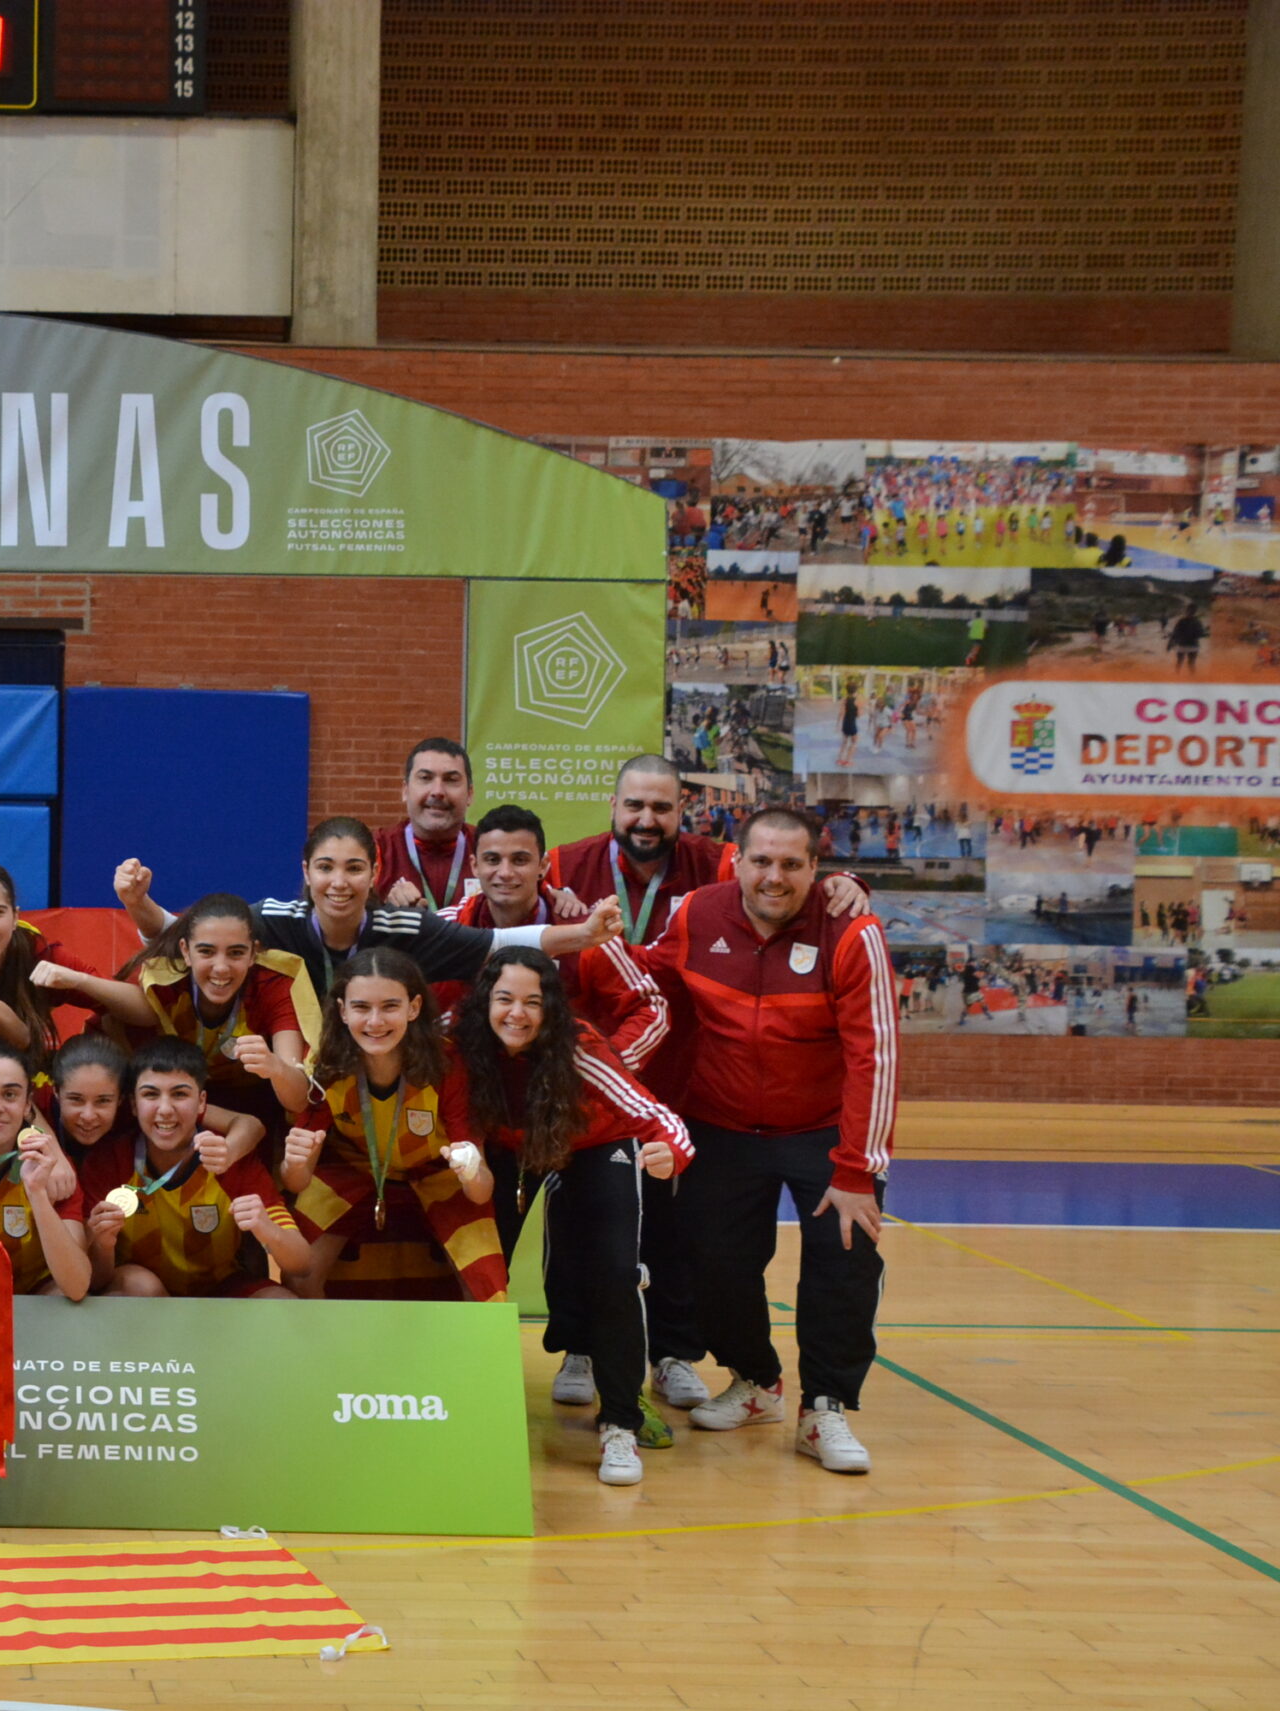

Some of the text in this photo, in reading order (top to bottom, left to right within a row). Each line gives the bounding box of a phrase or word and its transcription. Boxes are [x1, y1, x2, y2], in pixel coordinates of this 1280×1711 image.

[175, 11, 195, 30] 12
[175, 34, 194, 52] 13
[174, 57, 194, 75] 14
[174, 80, 194, 98] 15
[287, 518, 405, 529] SELECCIONES
[286, 528, 405, 540] AUTONÓMICAS
[287, 543, 405, 552] FUTSAL FEMENINO
[486, 742, 644, 753] CAMPEONATO DE ESPAÑA
[485, 757, 629, 770] SELECCIONE
[485, 770, 616, 785] AUTONÓMIC
[1081, 773, 1263, 787] AYUNTAMIENTO
[486, 790, 611, 802] FUTSAL FEMEN
[73, 1361, 101, 1372] DE
[109, 1359, 196, 1374] ESPAÑA
[38, 1444, 199, 1462] FEMENINO
